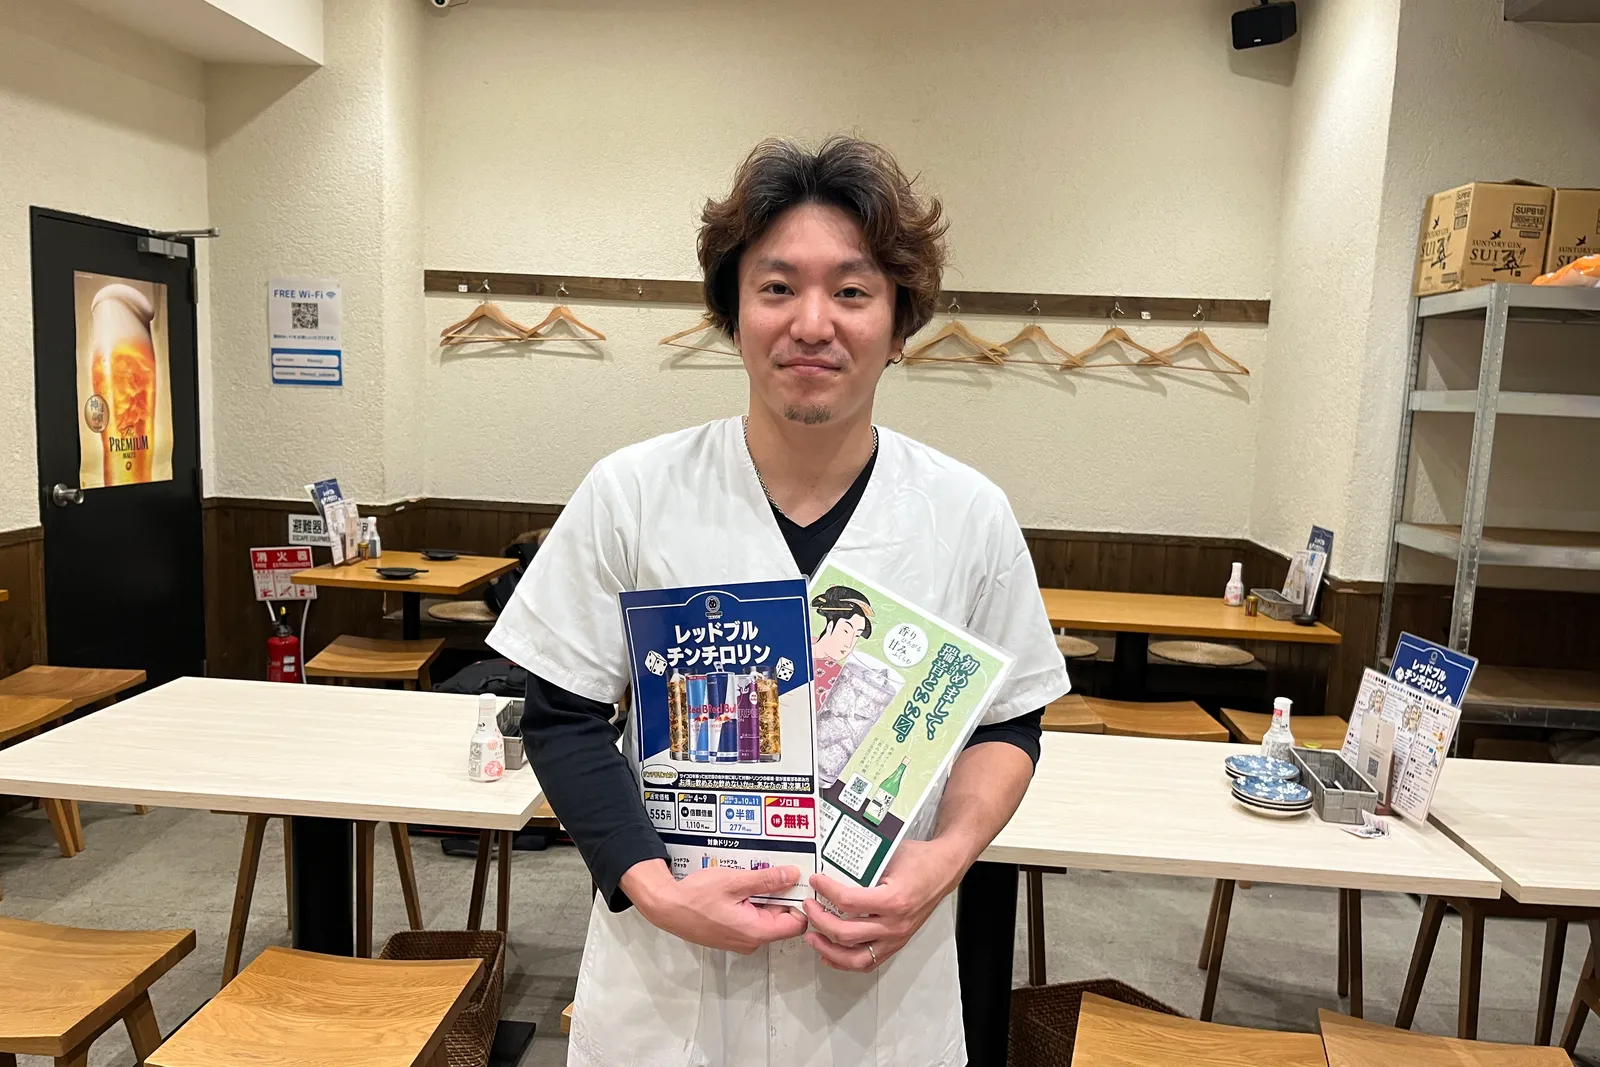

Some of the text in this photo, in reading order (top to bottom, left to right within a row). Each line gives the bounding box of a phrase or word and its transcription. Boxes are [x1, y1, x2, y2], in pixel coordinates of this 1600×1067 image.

[1420, 241, 1435, 258] SUI
[1471, 239, 1507, 248] SUNTORY
[1558, 246, 1592, 254] SUNTORY
[1469, 249, 1498, 262] SUI
[273, 289, 324, 299] FREE Wi-Fi
[109, 436, 149, 452] PREMIUM
[293, 519, 329, 535] 避難器
[256, 551, 308, 563] 消火器
[674, 620, 759, 644] レッドブル
[898, 626, 917, 640] 香り
[888, 638, 907, 655] 甘み
[666, 643, 771, 667] チンチロリン
[1411, 658, 1447, 682] レッドブル
[1404, 669, 1447, 695] チンチロリン
[735, 808, 755, 821] 半額
[783, 813, 810, 830] 無料
[707, 838, 740, 848] 対象ドリンク
